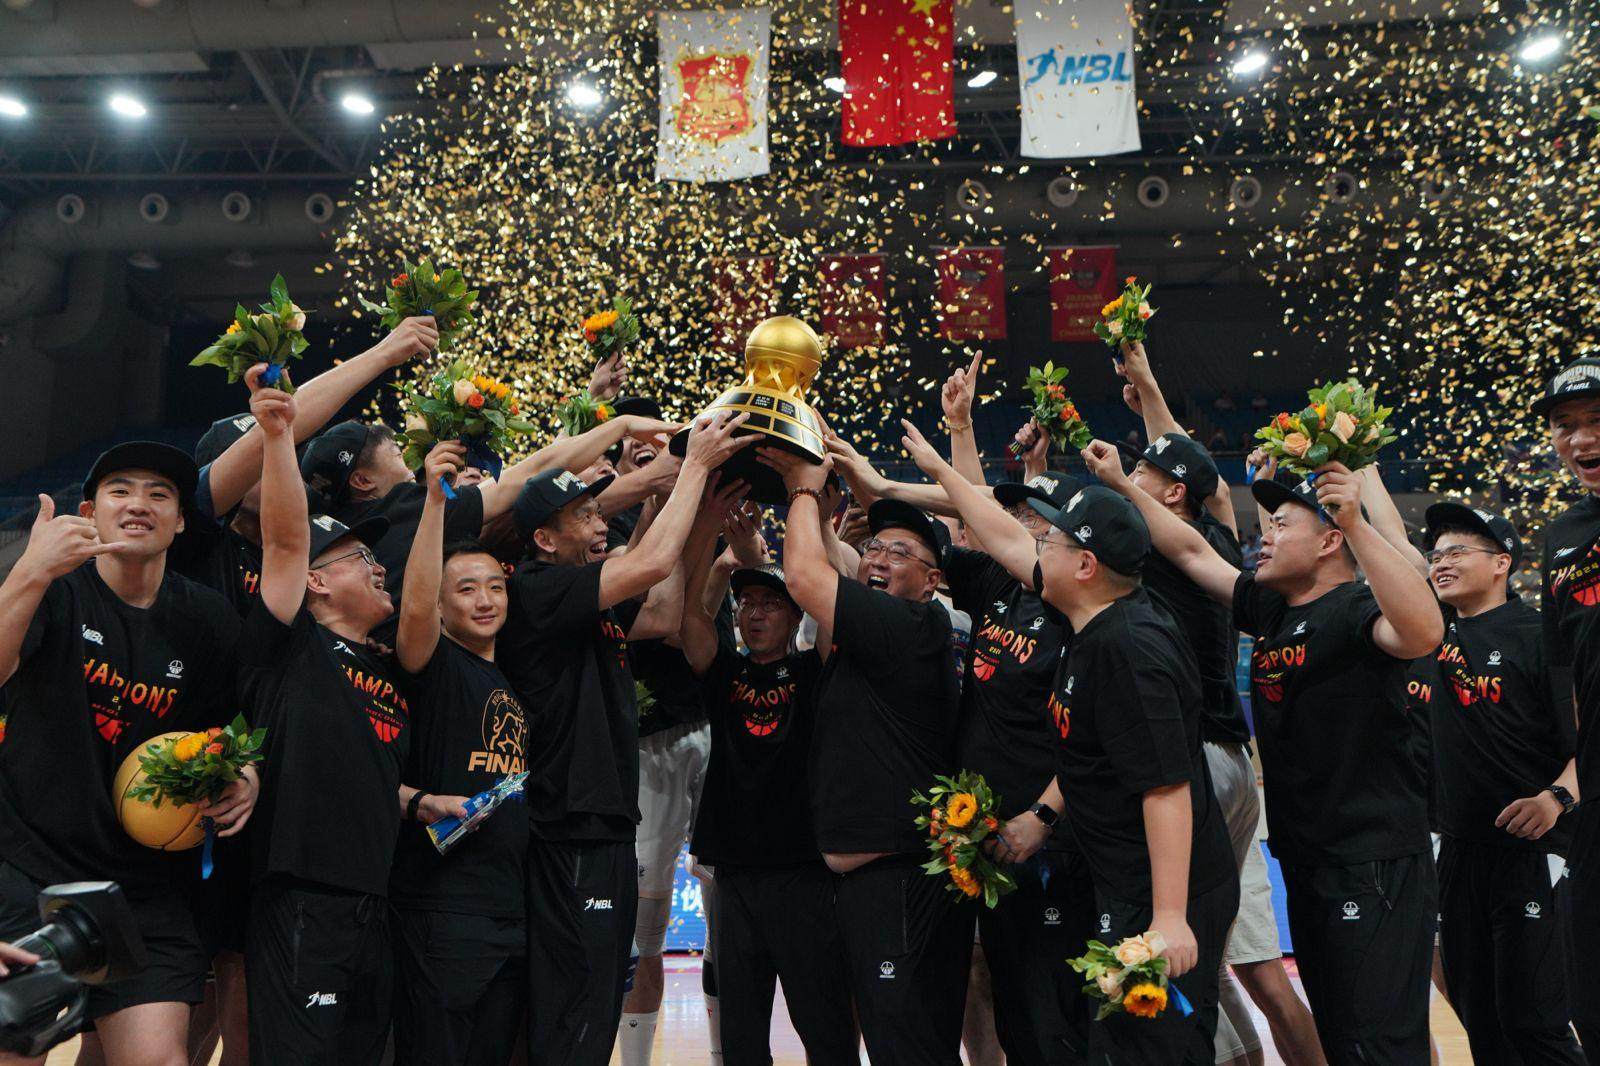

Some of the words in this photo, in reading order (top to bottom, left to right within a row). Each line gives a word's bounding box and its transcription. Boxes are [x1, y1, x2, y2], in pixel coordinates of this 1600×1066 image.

[1058, 52, 1131, 85] NBL
[594, 899, 613, 910] NBL
[319, 992, 338, 1006] NBL
